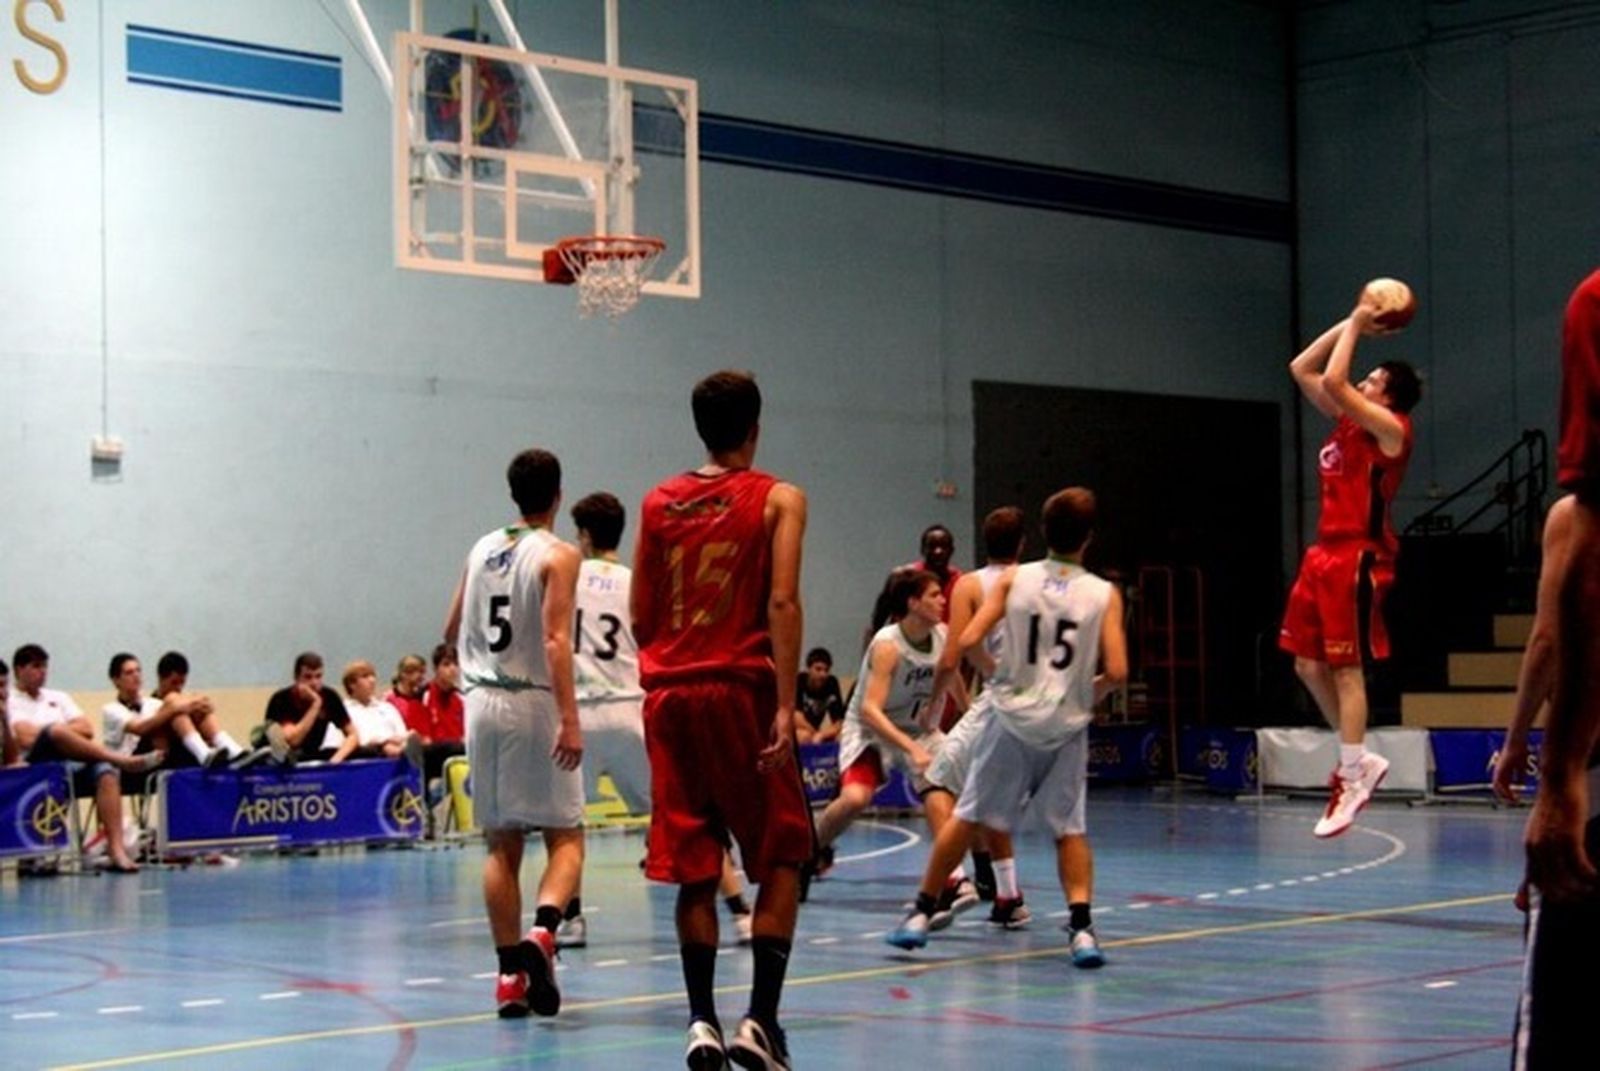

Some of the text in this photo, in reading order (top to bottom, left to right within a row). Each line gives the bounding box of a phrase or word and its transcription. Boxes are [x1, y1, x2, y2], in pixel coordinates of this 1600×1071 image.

[13, 0, 68, 96] S
[664, 540, 740, 631] 15
[489, 595, 513, 653] 5
[573, 608, 621, 661] 13
[1027, 613, 1078, 672] 15
[232, 795, 337, 832] ARISTOS
